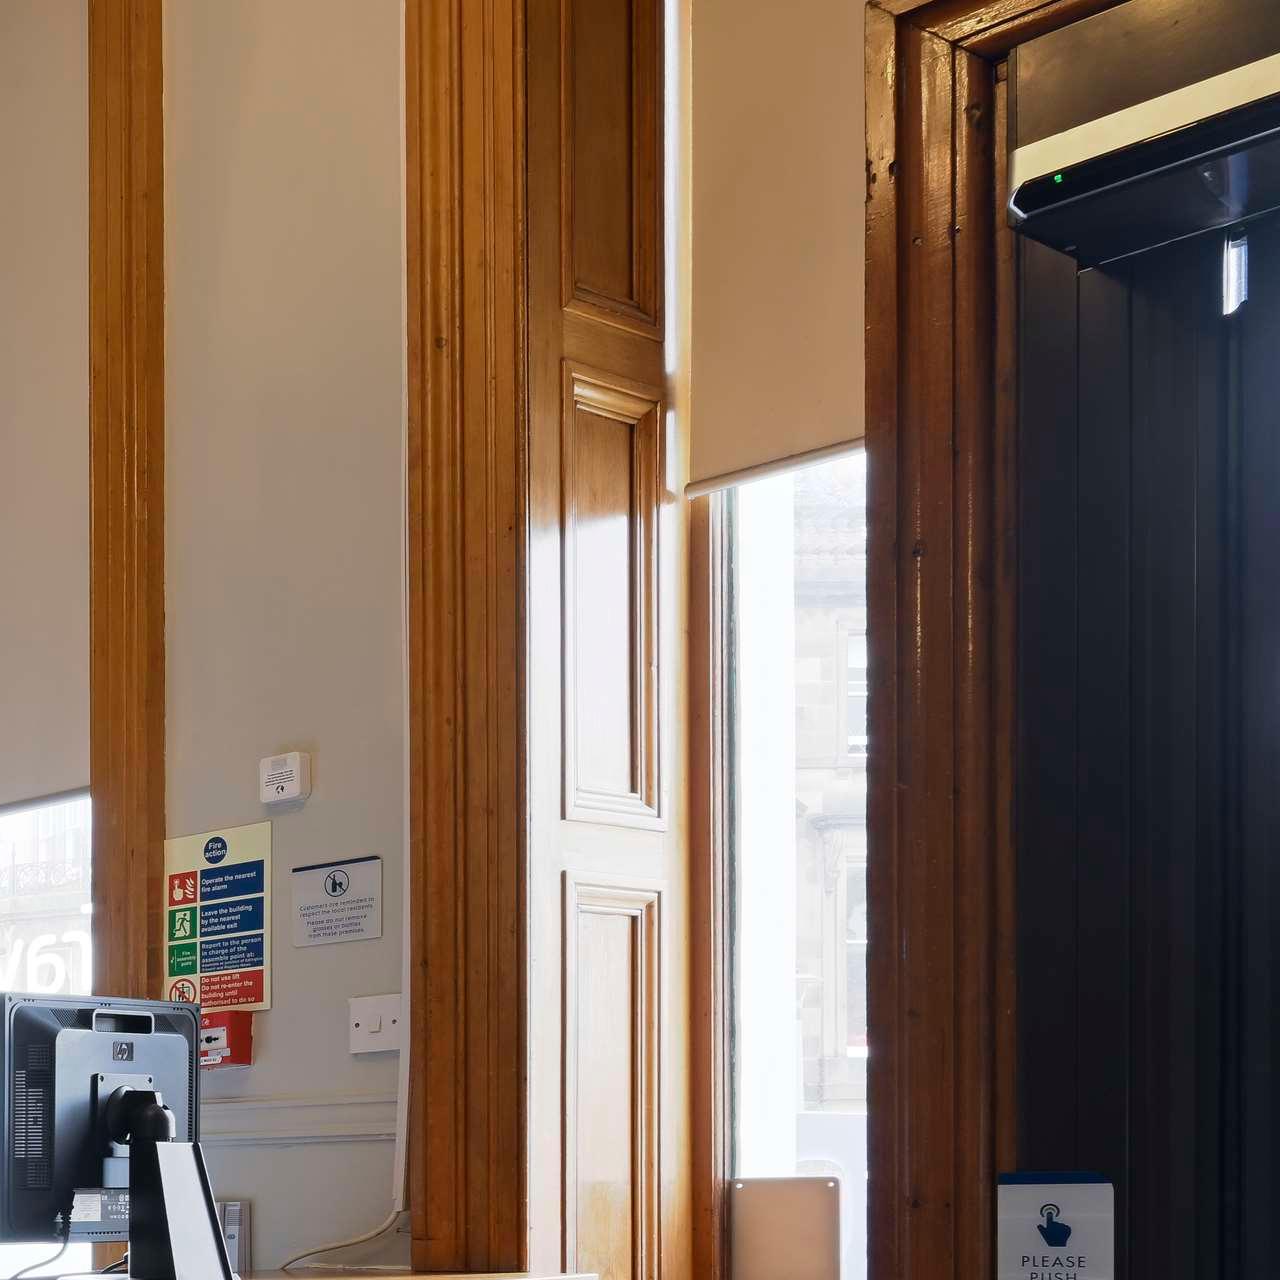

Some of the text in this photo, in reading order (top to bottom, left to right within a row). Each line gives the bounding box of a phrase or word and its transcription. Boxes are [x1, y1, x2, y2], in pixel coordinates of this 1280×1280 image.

[208, 842, 222, 850] Fire
[204, 849, 226, 858] action
[201, 877, 224, 886] Operate
[234, 871, 256, 880] nearest
[228, 904, 253, 912] building
[219, 914, 241, 922] nearest
[201, 924, 226, 932] available
[201, 942, 221, 950] Report
[240, 937, 262, 946] person
[220, 981, 243, 989] re-enter
[201, 992, 224, 1000] building
[1021, 1255, 1086, 1268] PLEASE
